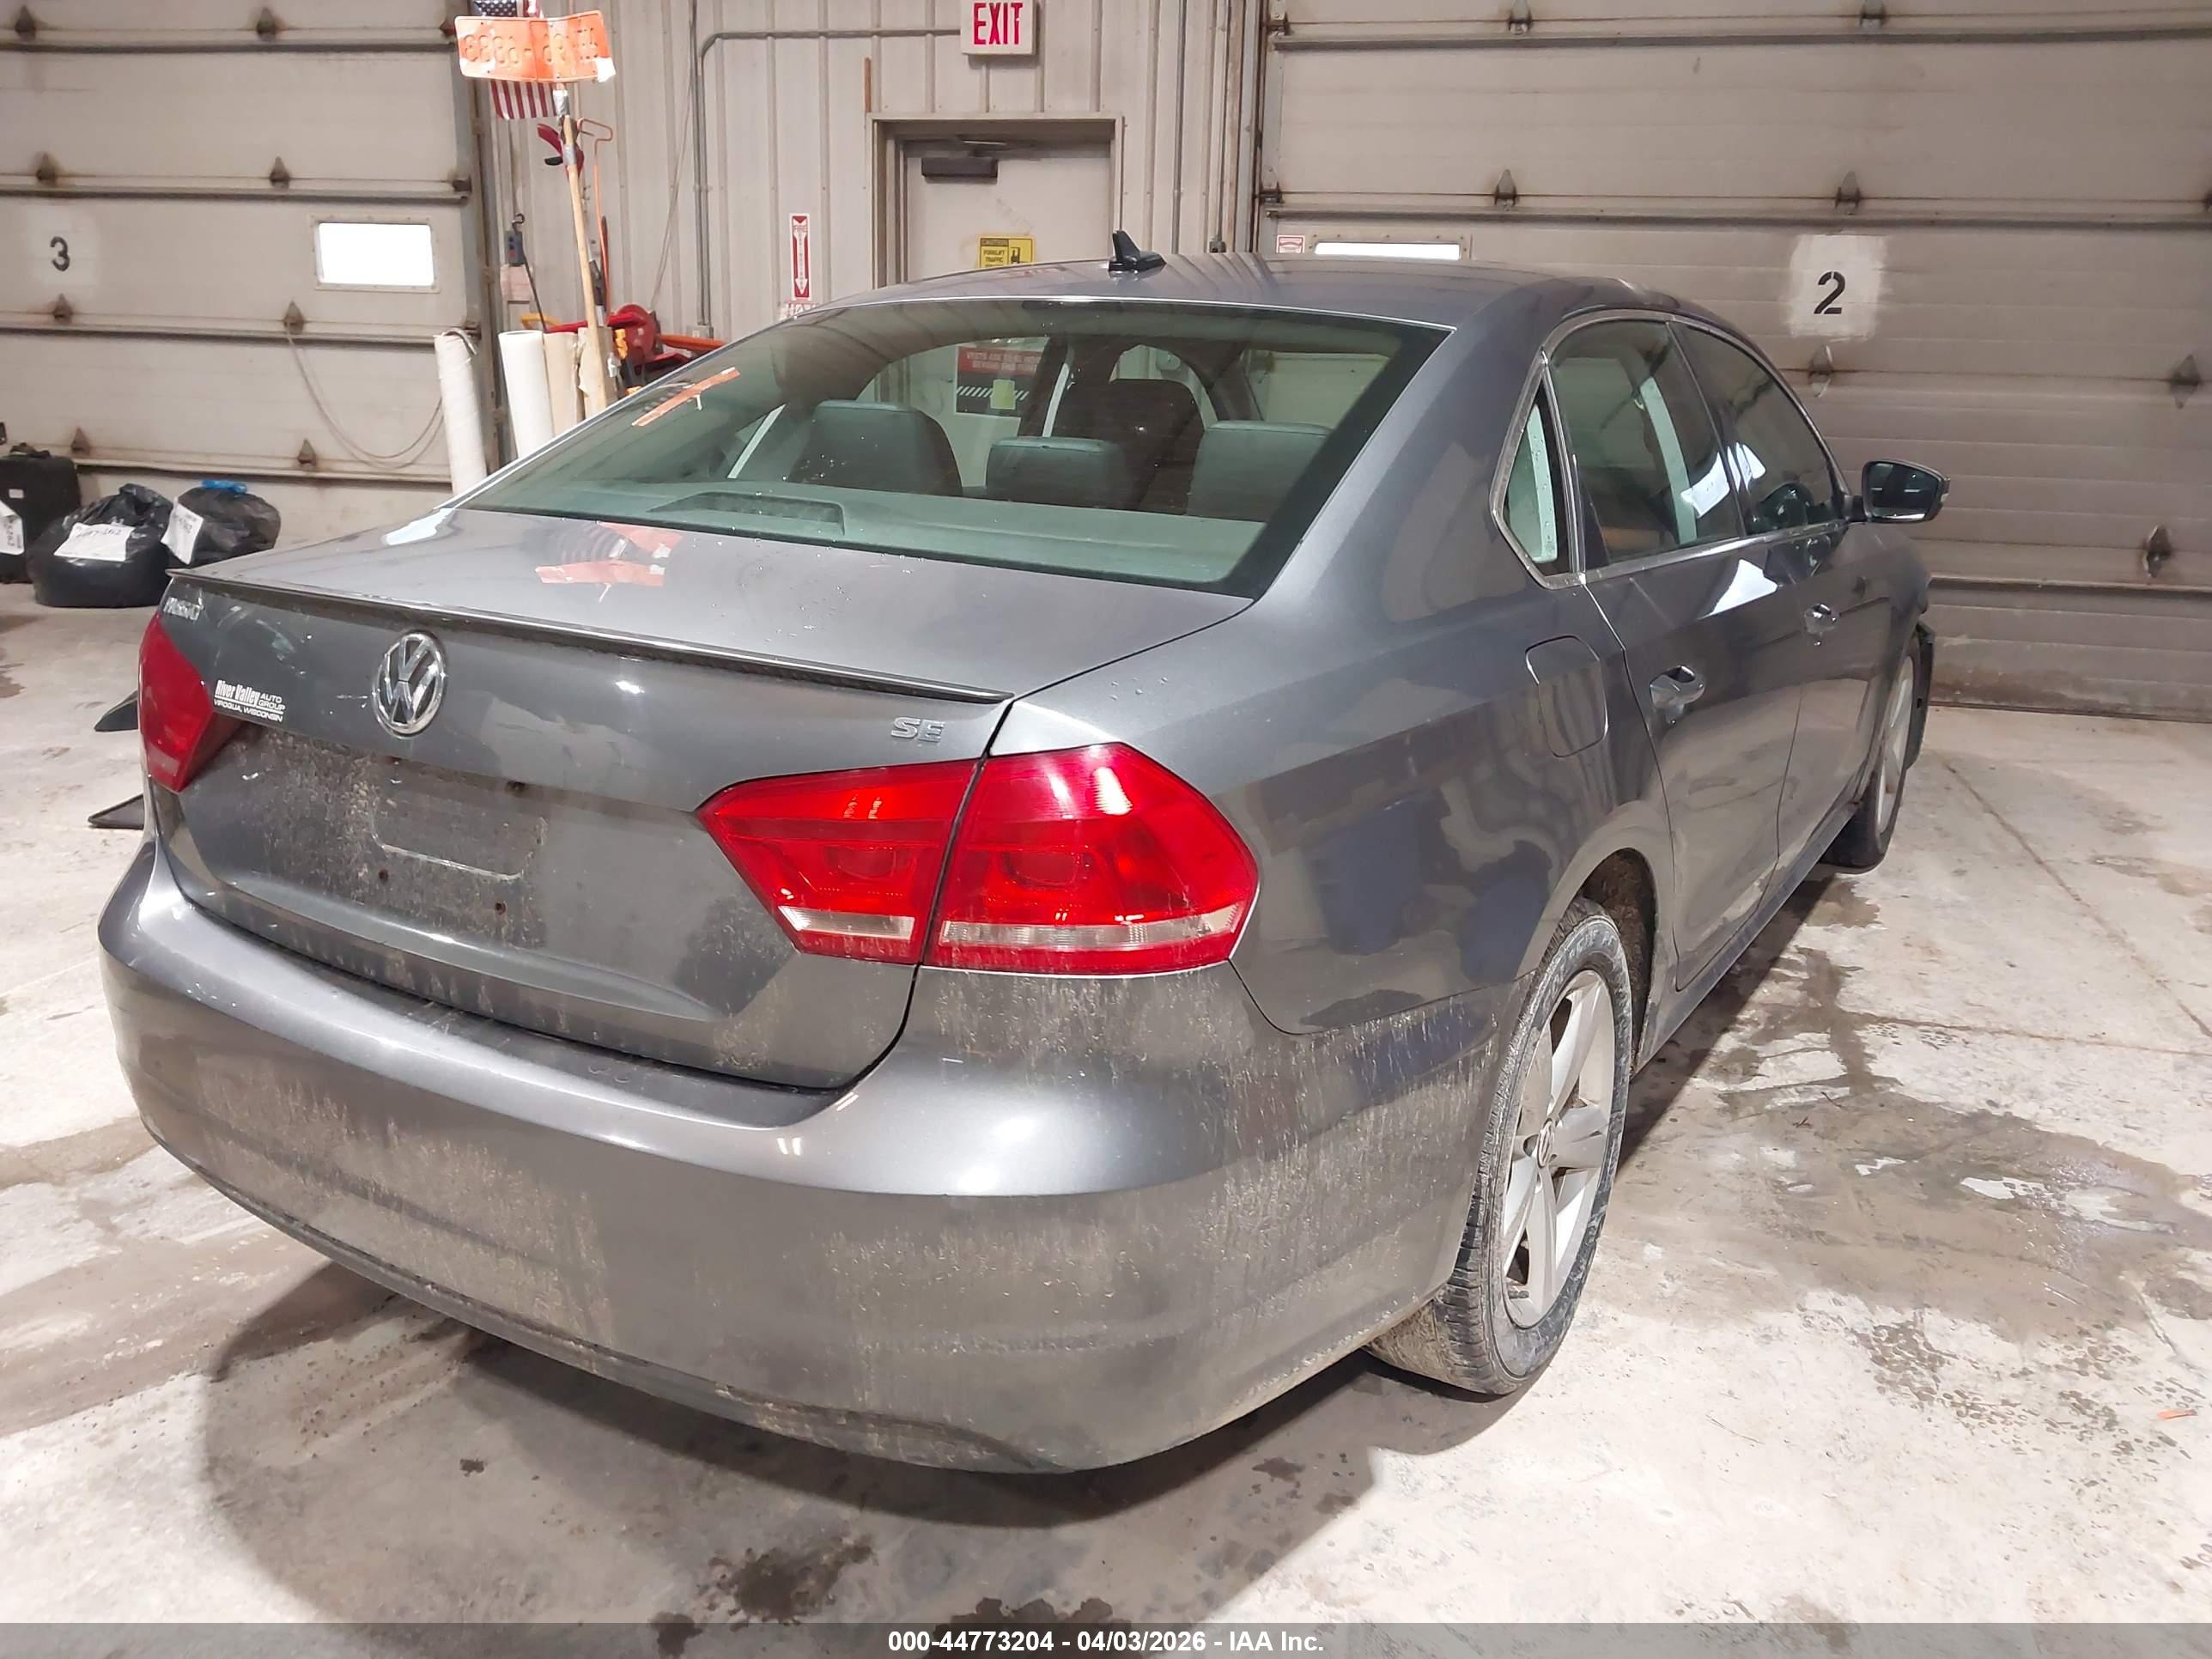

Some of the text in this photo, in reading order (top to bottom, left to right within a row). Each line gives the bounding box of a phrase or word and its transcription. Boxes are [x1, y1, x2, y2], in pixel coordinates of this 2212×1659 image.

[974, 3, 1023, 45] EXIT
[50, 236, 70, 271] 3
[1814, 271, 1846, 314] 2
[215, 679, 261, 706] River Valley
[258, 700, 285, 710] GROUP
[260, 693, 283, 703] AUTO
[243, 707, 283, 722] WISCONSIN
[890, 716, 945, 743] SE
